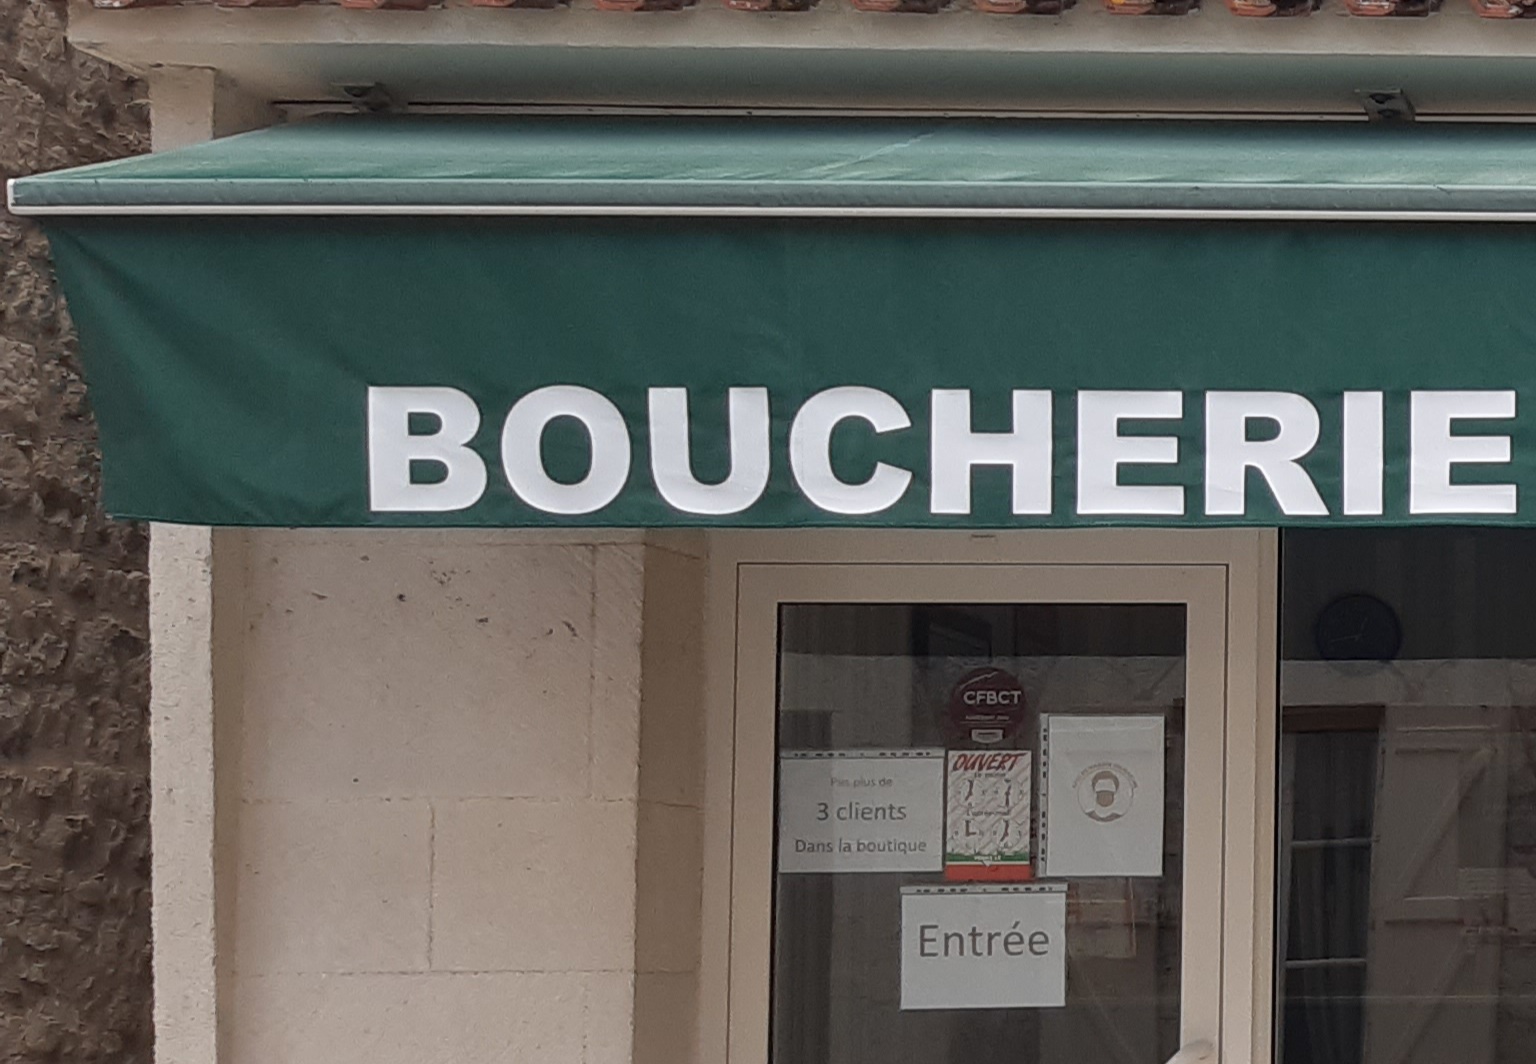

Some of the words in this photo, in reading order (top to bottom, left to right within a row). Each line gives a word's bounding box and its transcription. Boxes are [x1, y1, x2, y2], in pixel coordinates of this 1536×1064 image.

[367, 386, 1517, 516] BOUCHERIE
[963, 690, 1022, 705] CFBCT
[952, 752, 1028, 771] OUVERT
[853, 776, 876, 788] plus
[878, 777, 893, 787] de
[816, 802, 829, 821] 3
[836, 802, 907, 821] clients
[795, 838, 833, 853] Dans
[838, 837, 852, 853] la
[856, 838, 927, 854] boutique
[919, 921, 1049, 957] Entrée
